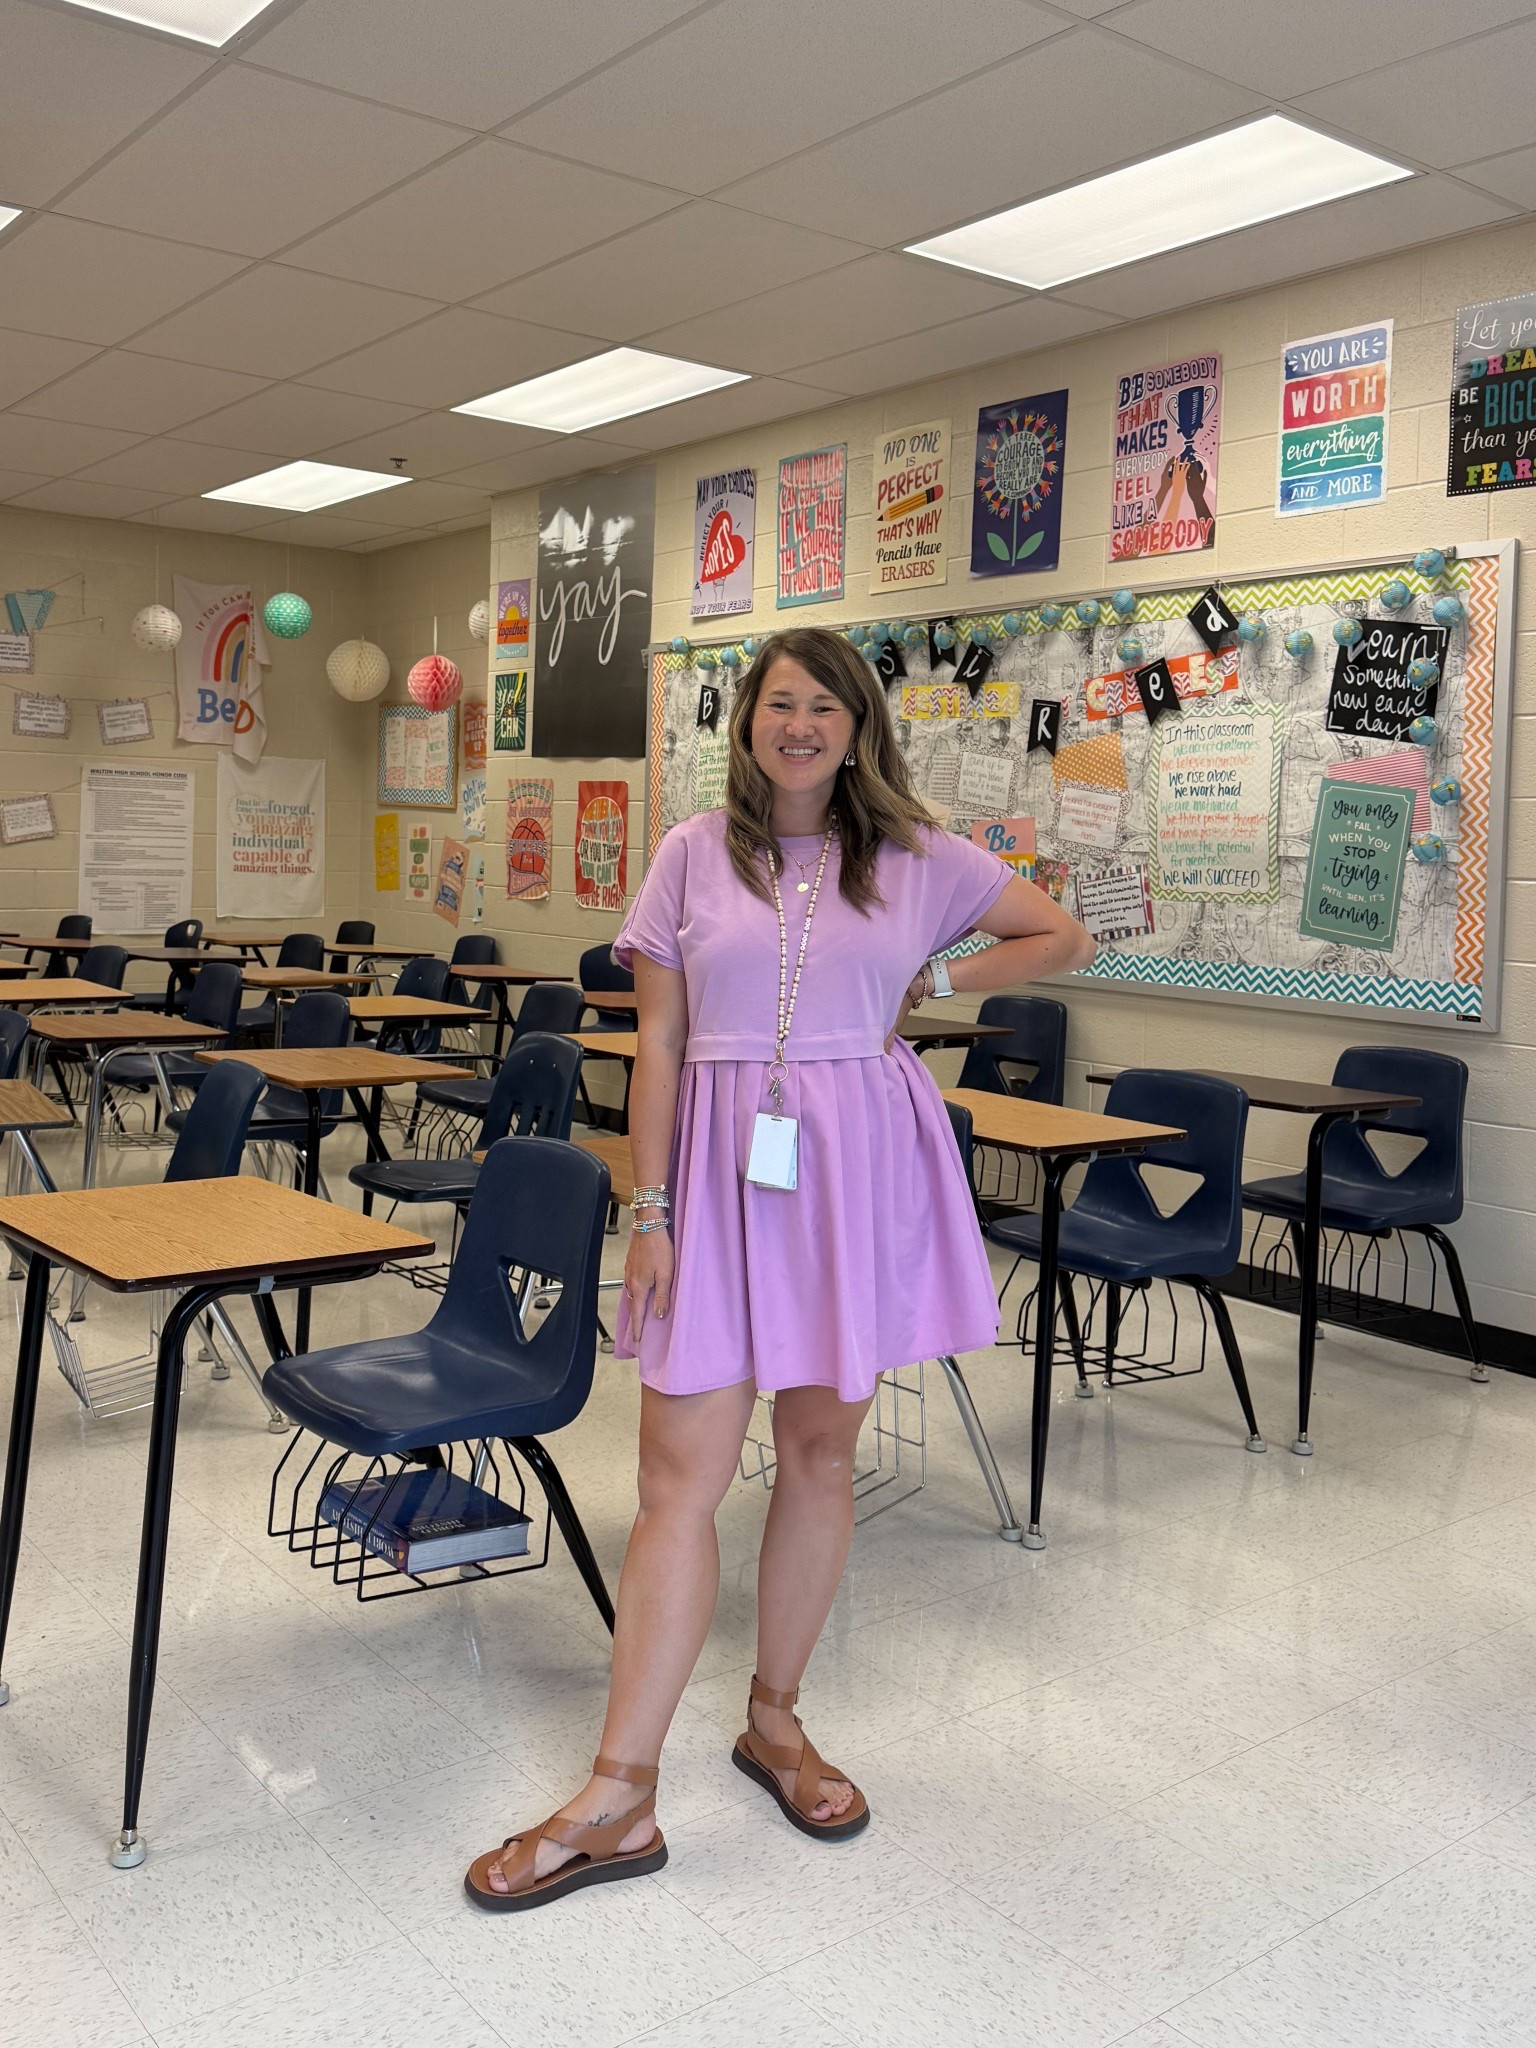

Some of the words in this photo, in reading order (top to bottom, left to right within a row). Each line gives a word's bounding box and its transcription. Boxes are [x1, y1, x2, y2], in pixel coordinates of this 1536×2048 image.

[1462, 310, 1503, 350] Let
[1301, 347, 1332, 371] YOU
[1339, 338, 1369, 364] ARE
[1119, 373, 1145, 410] BE
[1147, 357, 1217, 391] SOMEBODY
[1291, 375, 1377, 418] WORTH
[1459, 386, 1479, 405] BE
[1118, 392, 1163, 434] THAT
[884, 439, 905, 465] NO
[910, 431, 941, 454] ONE
[1116, 419, 1168, 457] MAKES
[1287, 424, 1380, 466] everything
[1461, 428, 1507, 454] than
[905, 456, 916, 467] IS
[996, 464, 1002, 472] TO
[1004, 459, 1020, 471] GROW
[1022, 457, 1030, 467] UP
[1032, 456, 1043, 466] AND
[998, 442, 1041, 463] COURAGE
[1116, 450, 1170, 479] EVERYBODY
[793, 460, 810, 487] OUR
[877, 459, 943, 510] PERFECT
[996, 470, 1016, 481] BECOME
[1019, 468, 1029, 477] WHO
[1032, 465, 1042, 475] YOU
[999, 480, 1022, 490] REALLY
[1024, 475, 1037, 488] ARE
[1291, 485, 1318, 500] AND
[1327, 473, 1373, 498] MORE
[696, 479, 709, 511] MAY
[711, 474, 727, 498] YOUR
[727, 468, 754, 499] CHOICES
[780, 486, 796, 513] CAN
[798, 487, 820, 509] COME
[822, 482, 843, 500] TRUE
[1114, 477, 1152, 503] FEEL
[779, 512, 790, 549] IF
[793, 508, 810, 542] WE
[815, 500, 842, 531] HAVE
[877, 518, 913, 543] THAT'S
[917, 508, 942, 537] WHY
[1113, 501, 1143, 530] LIKE
[1148, 498, 1157, 525] A
[700, 523, 711, 561] REFLECT
[708, 499, 724, 520] YOUR
[1112, 517, 1213, 558] SOMEBODY
[705, 518, 734, 577] HOPES
[779, 548, 797, 574] THE
[799, 528, 842, 567] COURAGE
[876, 544, 912, 564] Pencils
[914, 540, 942, 558] Have
[779, 573, 791, 598] TO
[791, 561, 820, 597] PURSUE
[821, 559, 842, 592] THEM
[881, 560, 935, 583] ERASERS
[195, 620, 205, 632] IF
[203, 603, 220, 620] YOU
[222, 594, 243, 607] CAN
[512, 591, 519, 601] IN
[518, 596, 529, 618] THIS
[540, 565, 648, 668] yay
[690, 604, 706, 616] NOT
[708, 602, 726, 613] YOUR
[727, 599, 751, 611] FEARS
[498, 620, 528, 643] together
[196, 688, 236, 723] Be
[1334, 690, 1367, 710] new
[1375, 694, 1427, 717] each
[500, 717, 519, 738] CAN
[1165, 726, 1181, 744] In
[1183, 724, 1205, 741] this
[1355, 710, 1410, 740] day
[1187, 769, 1204, 783] rise
[1207, 769, 1237, 782] above
[509, 783, 551, 804] SUCCESS
[1331, 799, 1362, 820] you
[1366, 803, 1398, 828] only
[1354, 821, 1371, 831] FAIL
[232, 832, 304, 849] individual
[252, 824, 313, 838] amazing
[985, 824, 1017, 853] Be
[1328, 832, 1362, 843] WHEN
[1368, 836, 1391, 852] YOU
[233, 849, 292, 864] capable
[297, 849, 312, 863] of
[580, 838, 589, 859] OR
[589, 841, 601, 863] YOU
[602, 843, 621, 862] THINK
[1170, 855, 1185, 867] for
[1186, 854, 1229, 868] greatness
[1175, 841, 1198, 853] have
[1198, 841, 1212, 856] the
[1216, 841, 1254, 857] potential
[1343, 845, 1376, 860] STOP
[233, 863, 277, 875] amazing
[281, 864, 315, 875] things.
[581, 860, 595, 878] YOU
[596, 861, 617, 885] CAN'T
[1182, 870, 1202, 885] will
[1205, 868, 1260, 888] SUCCEED
[1329, 857, 1381, 891] trying
[576, 885, 600, 908] YOU'RE
[602, 882, 625, 909] RIGHT
[1321, 883, 1342, 898] UNTIL
[1369, 893, 1385, 902] IT'S
[1318, 897, 1385, 931] learning.
